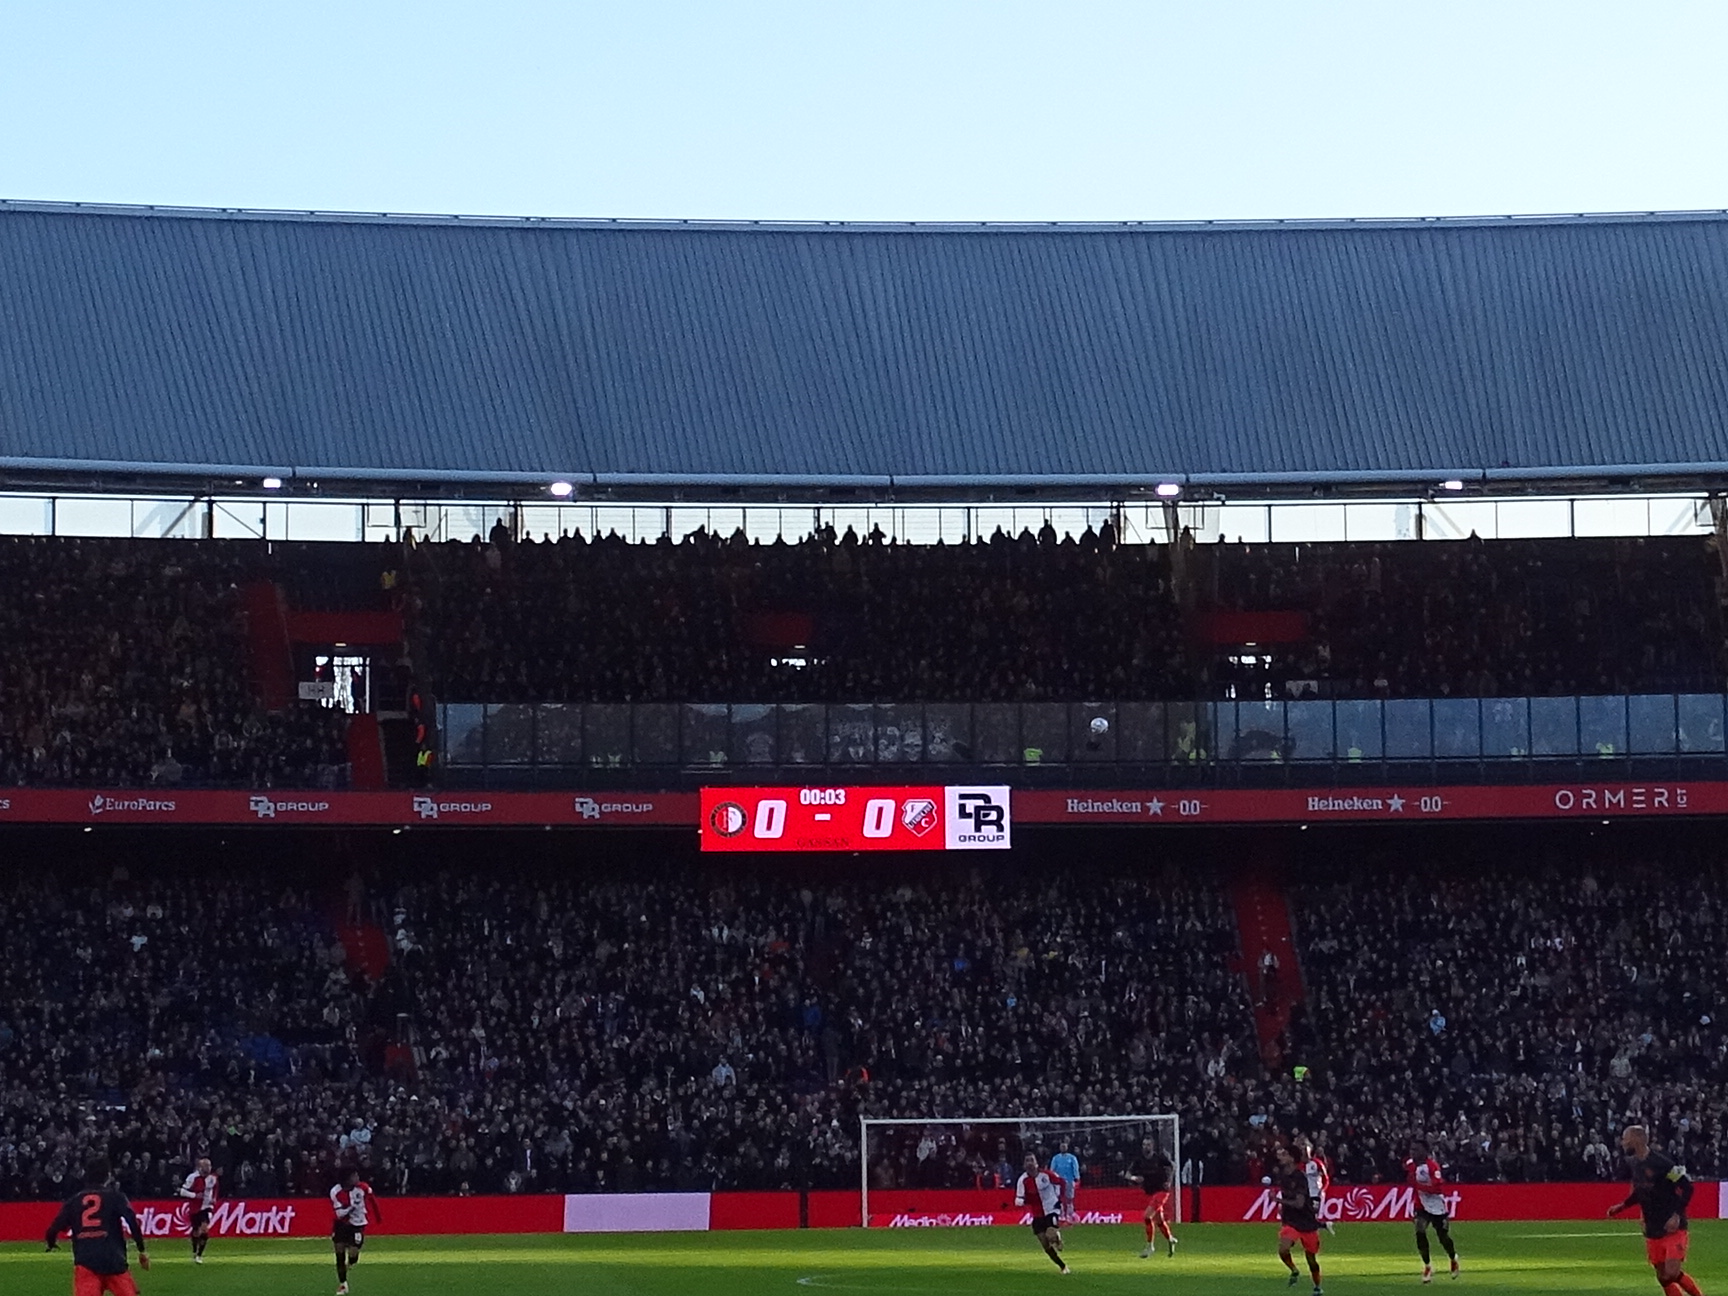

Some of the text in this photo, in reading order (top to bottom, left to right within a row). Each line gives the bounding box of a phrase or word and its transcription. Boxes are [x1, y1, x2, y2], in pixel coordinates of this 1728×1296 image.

[105, 797, 176, 812] EuroParcs
[799, 788, 846, 805] 00:03
[1307, 795, 1383, 811] Heineken
[1555, 788, 1669, 810] ORMER
[276, 801, 329, 812] GROUP
[439, 801, 492, 813] GROUP
[601, 801, 653, 813] GROUP
[1066, 797, 1142, 813] Heineken
[753, 799, 787, 839] 0
[862, 798, 896, 839] 0
[958, 835, 1005, 843] GROUP
[81, 1192, 102, 1227] 2
[1242, 1188, 1344, 1220] Mia
[208, 1202, 296, 1234] Markt
[889, 1213, 994, 1227] Media Markt
[1080, 1211, 1123, 1224] Markt
